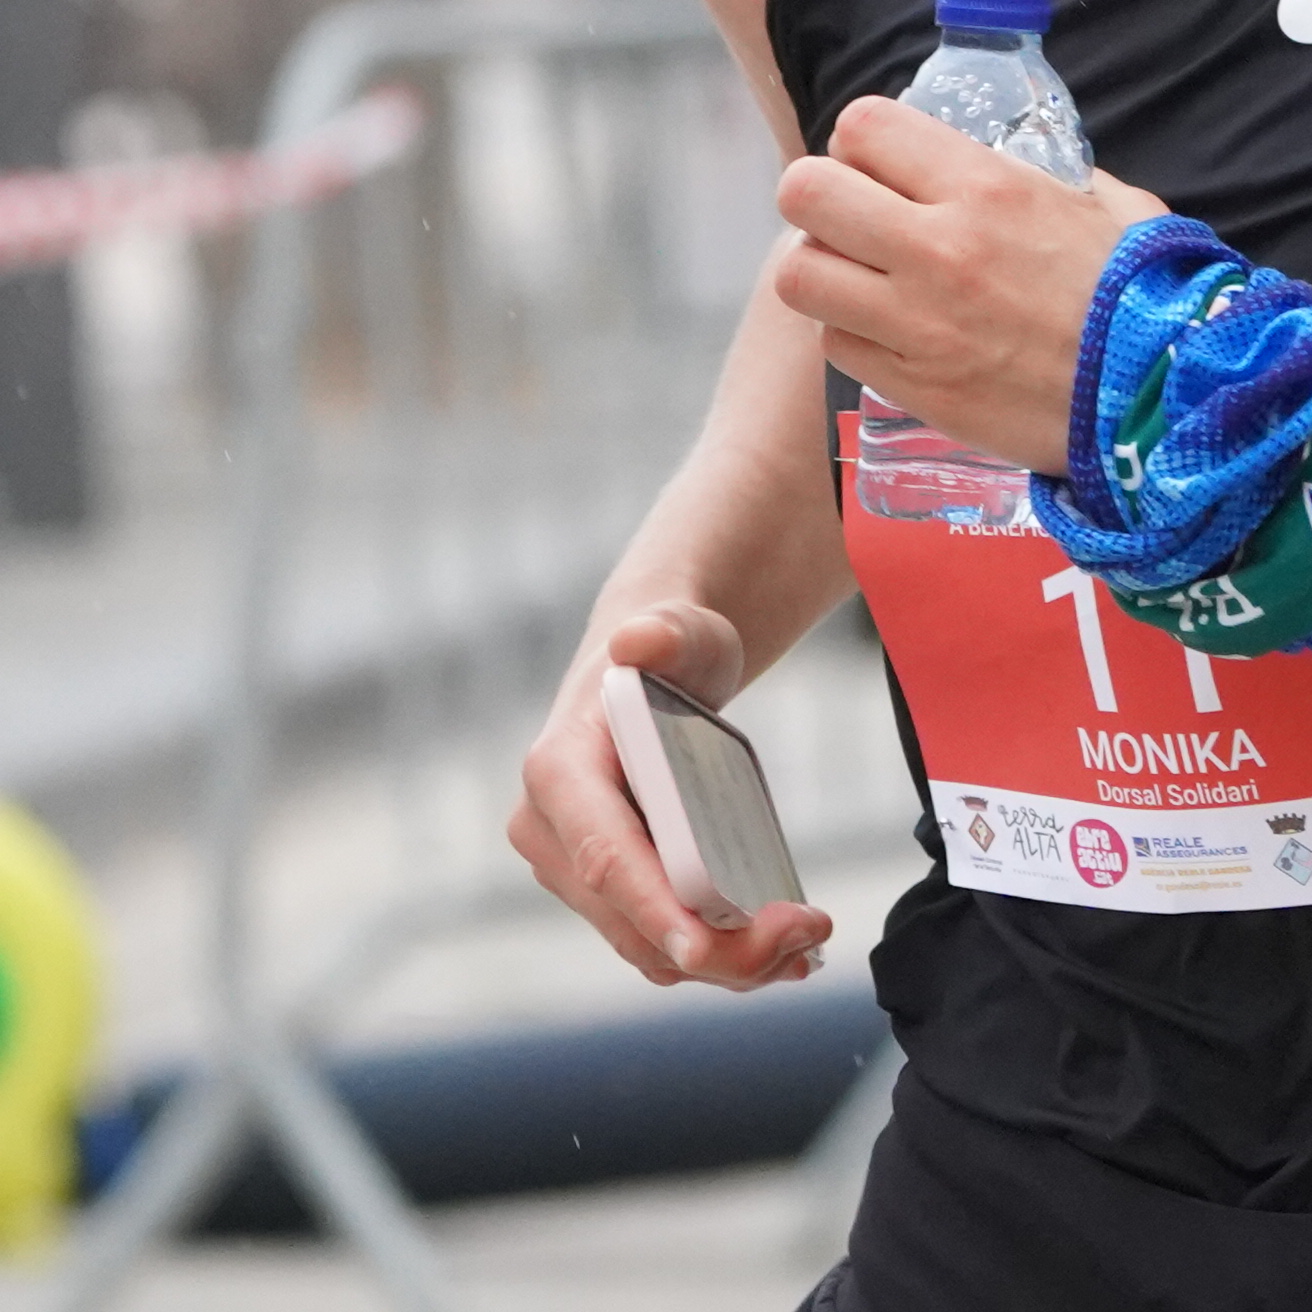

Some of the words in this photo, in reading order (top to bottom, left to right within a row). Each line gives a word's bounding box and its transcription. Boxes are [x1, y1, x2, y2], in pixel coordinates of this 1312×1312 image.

[1076, 726, 1268, 775] MONIKA
[1096, 779, 1164, 806] Dorsal
[1166, 778, 1261, 806] Solidari
[1012, 826, 1063, 863] ALTA
[1151, 836, 1206, 849] REALE
[1155, 845, 1249, 859] ASSEGURANCES
